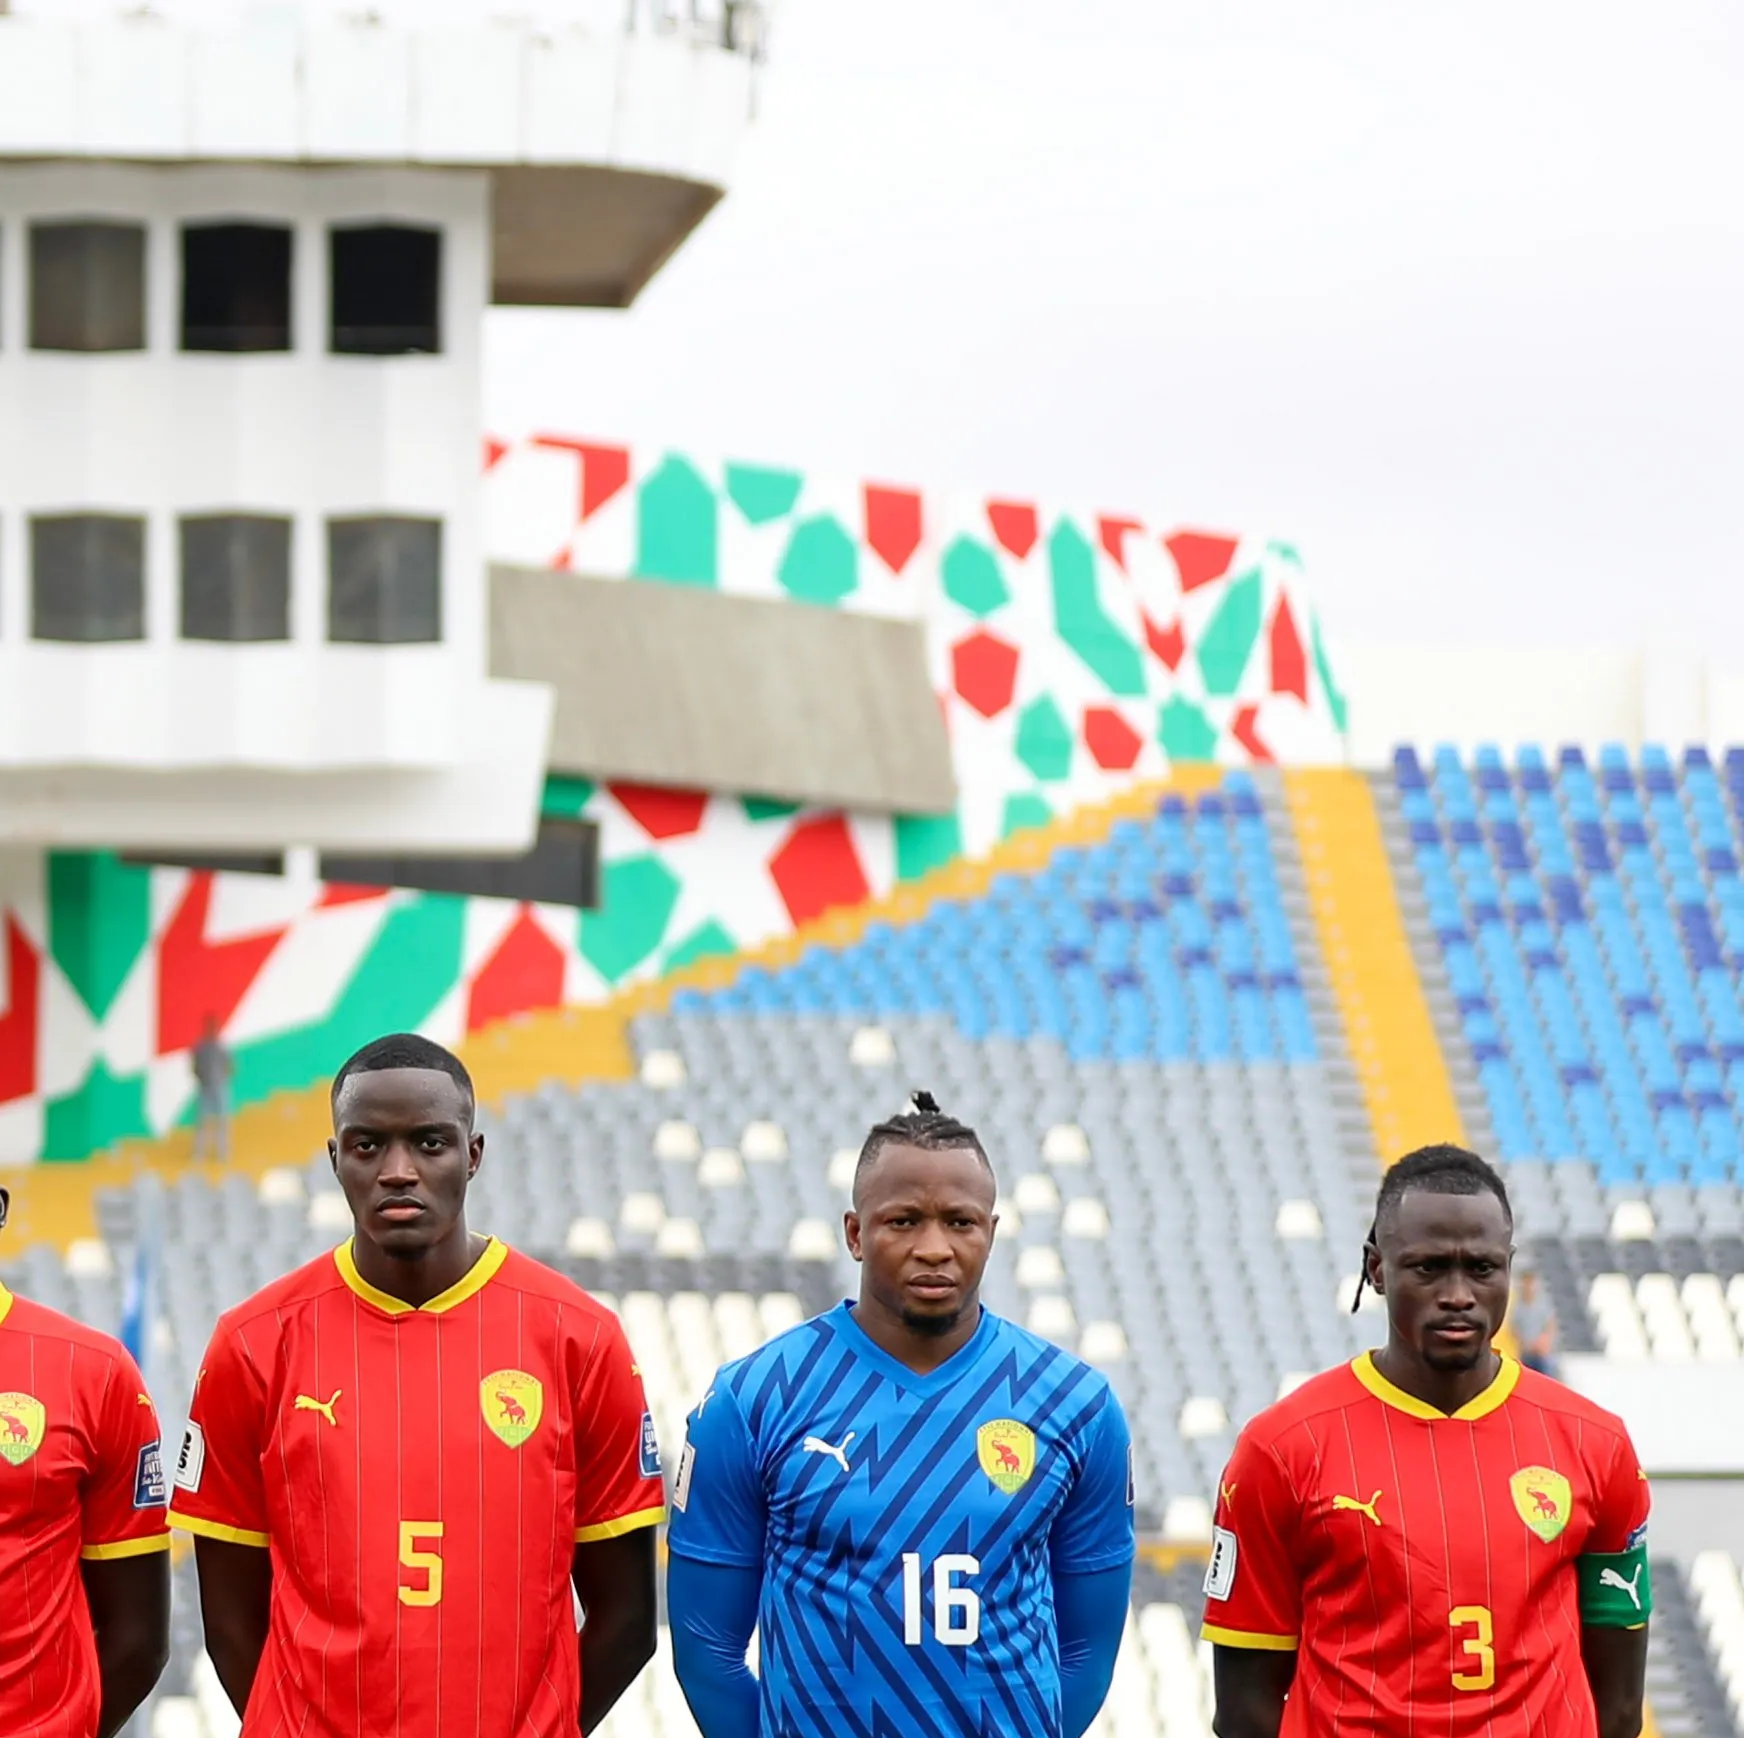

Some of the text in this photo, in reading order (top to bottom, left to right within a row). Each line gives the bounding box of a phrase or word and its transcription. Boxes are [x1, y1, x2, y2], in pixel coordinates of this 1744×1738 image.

[398, 1520, 444, 1607] 5
[902, 1552, 980, 1646] 16
[1448, 1605, 1495, 1691] 3
